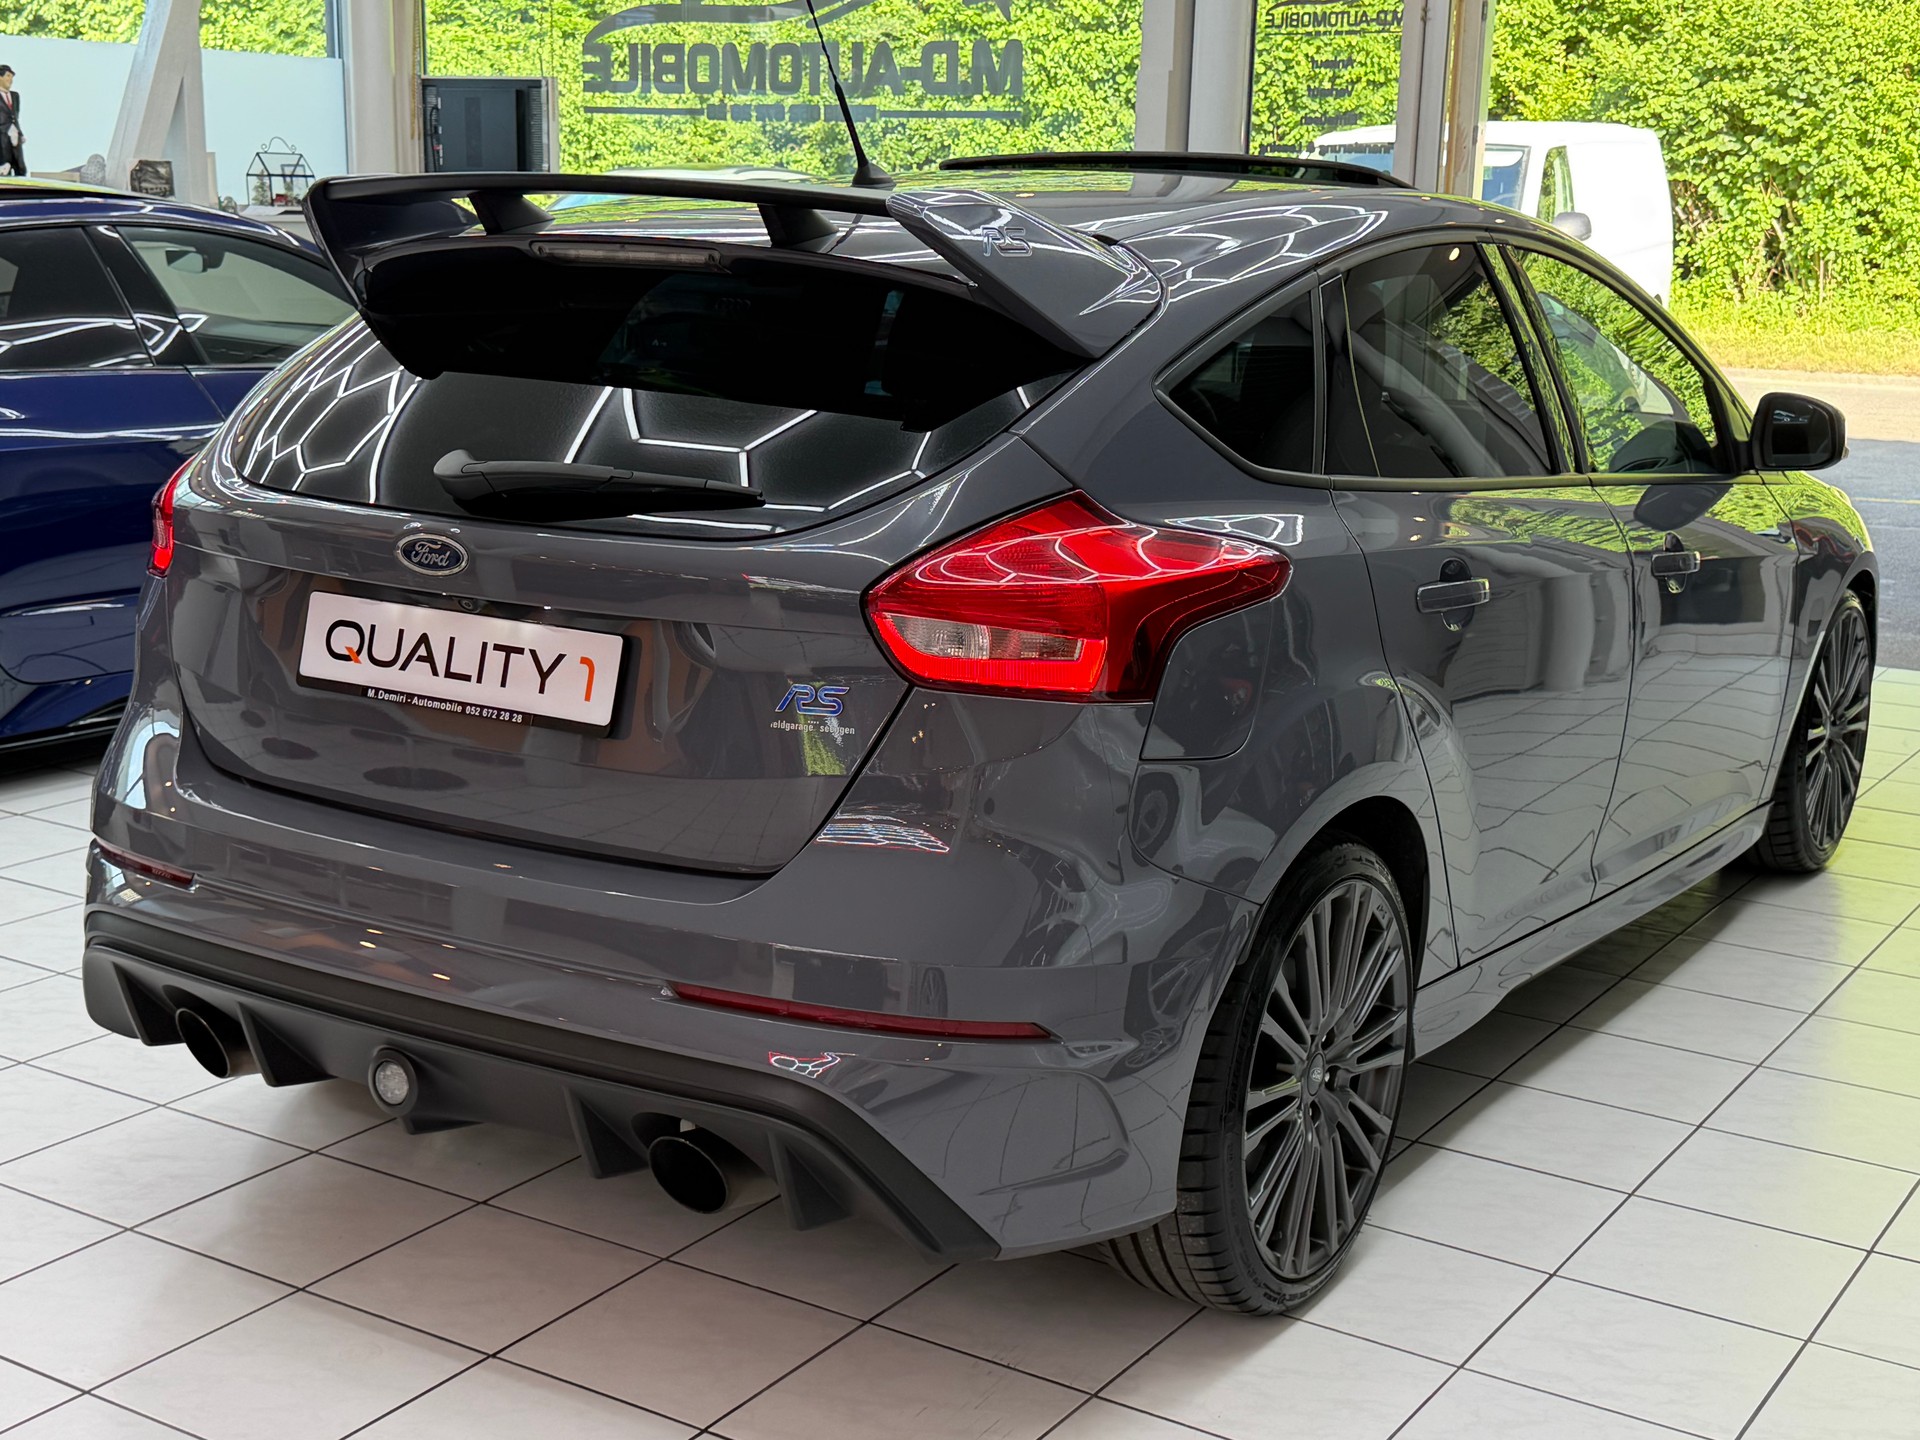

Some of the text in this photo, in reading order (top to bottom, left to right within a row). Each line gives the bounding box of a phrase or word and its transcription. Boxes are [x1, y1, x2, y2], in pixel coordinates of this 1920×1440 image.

[981, 225, 1032, 257] RS
[411, 541, 450, 566] Ford
[325, 619, 595, 703] QUALITY 1
[411, 696, 462, 713] Automobile
[465, 705, 481, 716] 052
[482, 708, 498, 719] 672
[499, 711, 510, 721] 28
[511, 713, 523, 723] 28
[775, 684, 850, 716] RS
